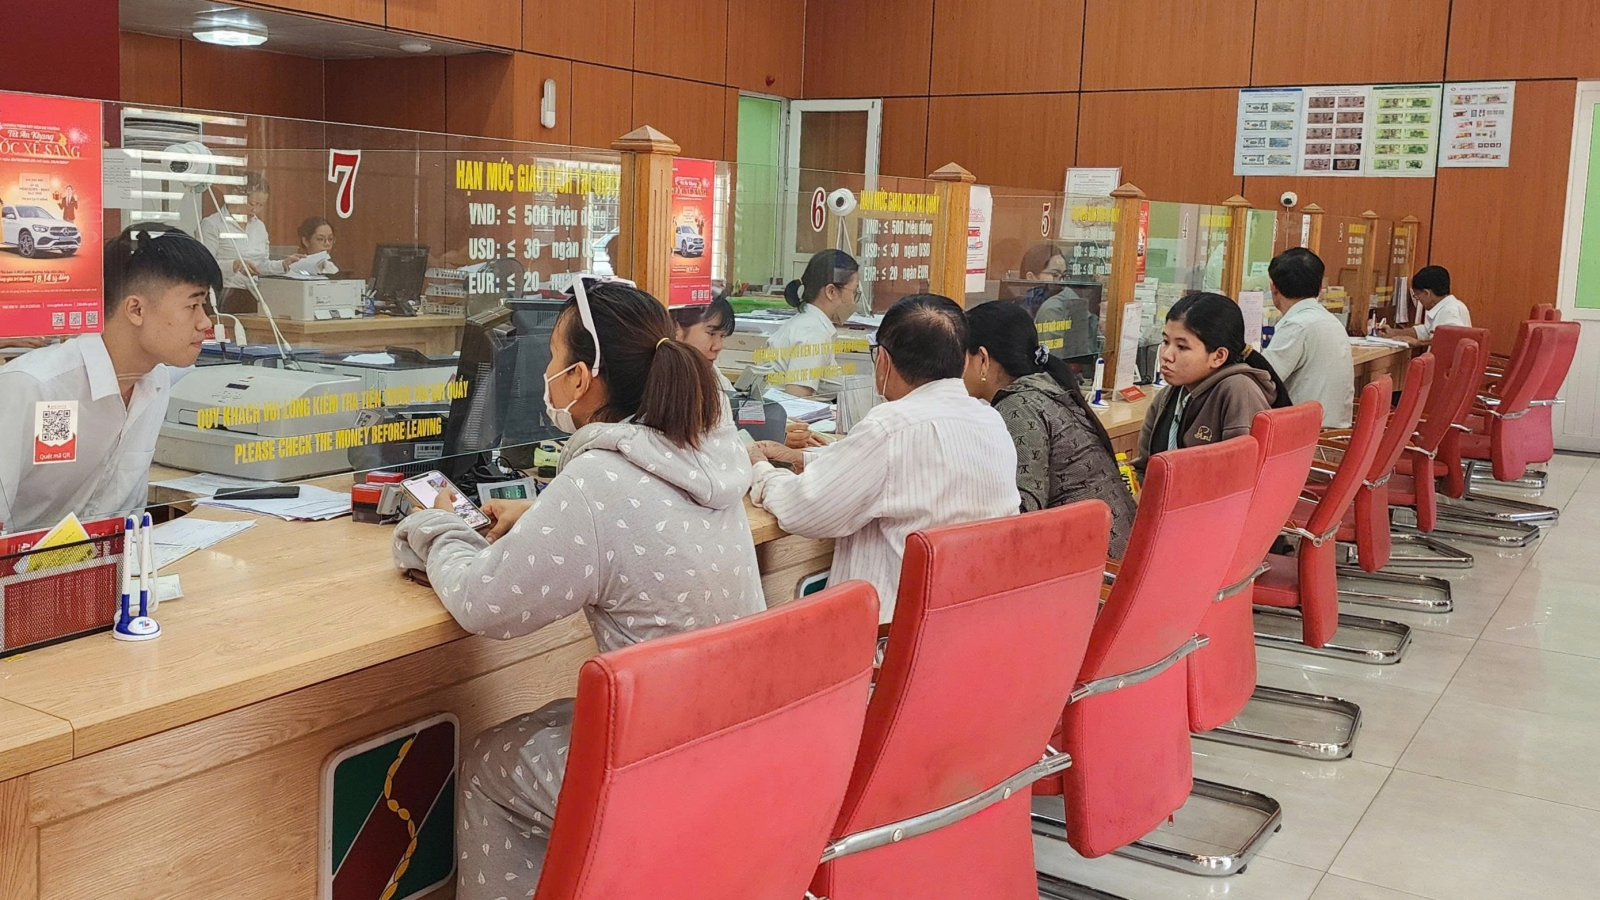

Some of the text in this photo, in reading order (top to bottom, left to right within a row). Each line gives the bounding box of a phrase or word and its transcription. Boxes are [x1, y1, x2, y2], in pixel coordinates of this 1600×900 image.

[44, 144, 80, 158] SANG
[328, 148, 361, 218] 7
[456, 159, 483, 196] HẠN
[487, 157, 515, 193] MỨC
[517, 163, 543, 193] GIAO
[524, 204, 548, 226] 500
[551, 205, 578, 231] triệu
[810, 186, 826, 232] 6
[1041, 202, 1051, 237] 5
[892, 219, 904, 235] 500
[469, 237, 500, 260] USD:
[524, 238, 540, 260] 30
[552, 237, 579, 261] ngàn
[891, 242, 899, 258] 30
[468, 272, 500, 295] EUR:
[523, 271, 540, 292] 20
[551, 269, 574, 291] ngà
[889, 265, 898, 281] 20
[234, 417, 442, 465] PLEASE CHECK THE MONEY BEFORE LEAVING
